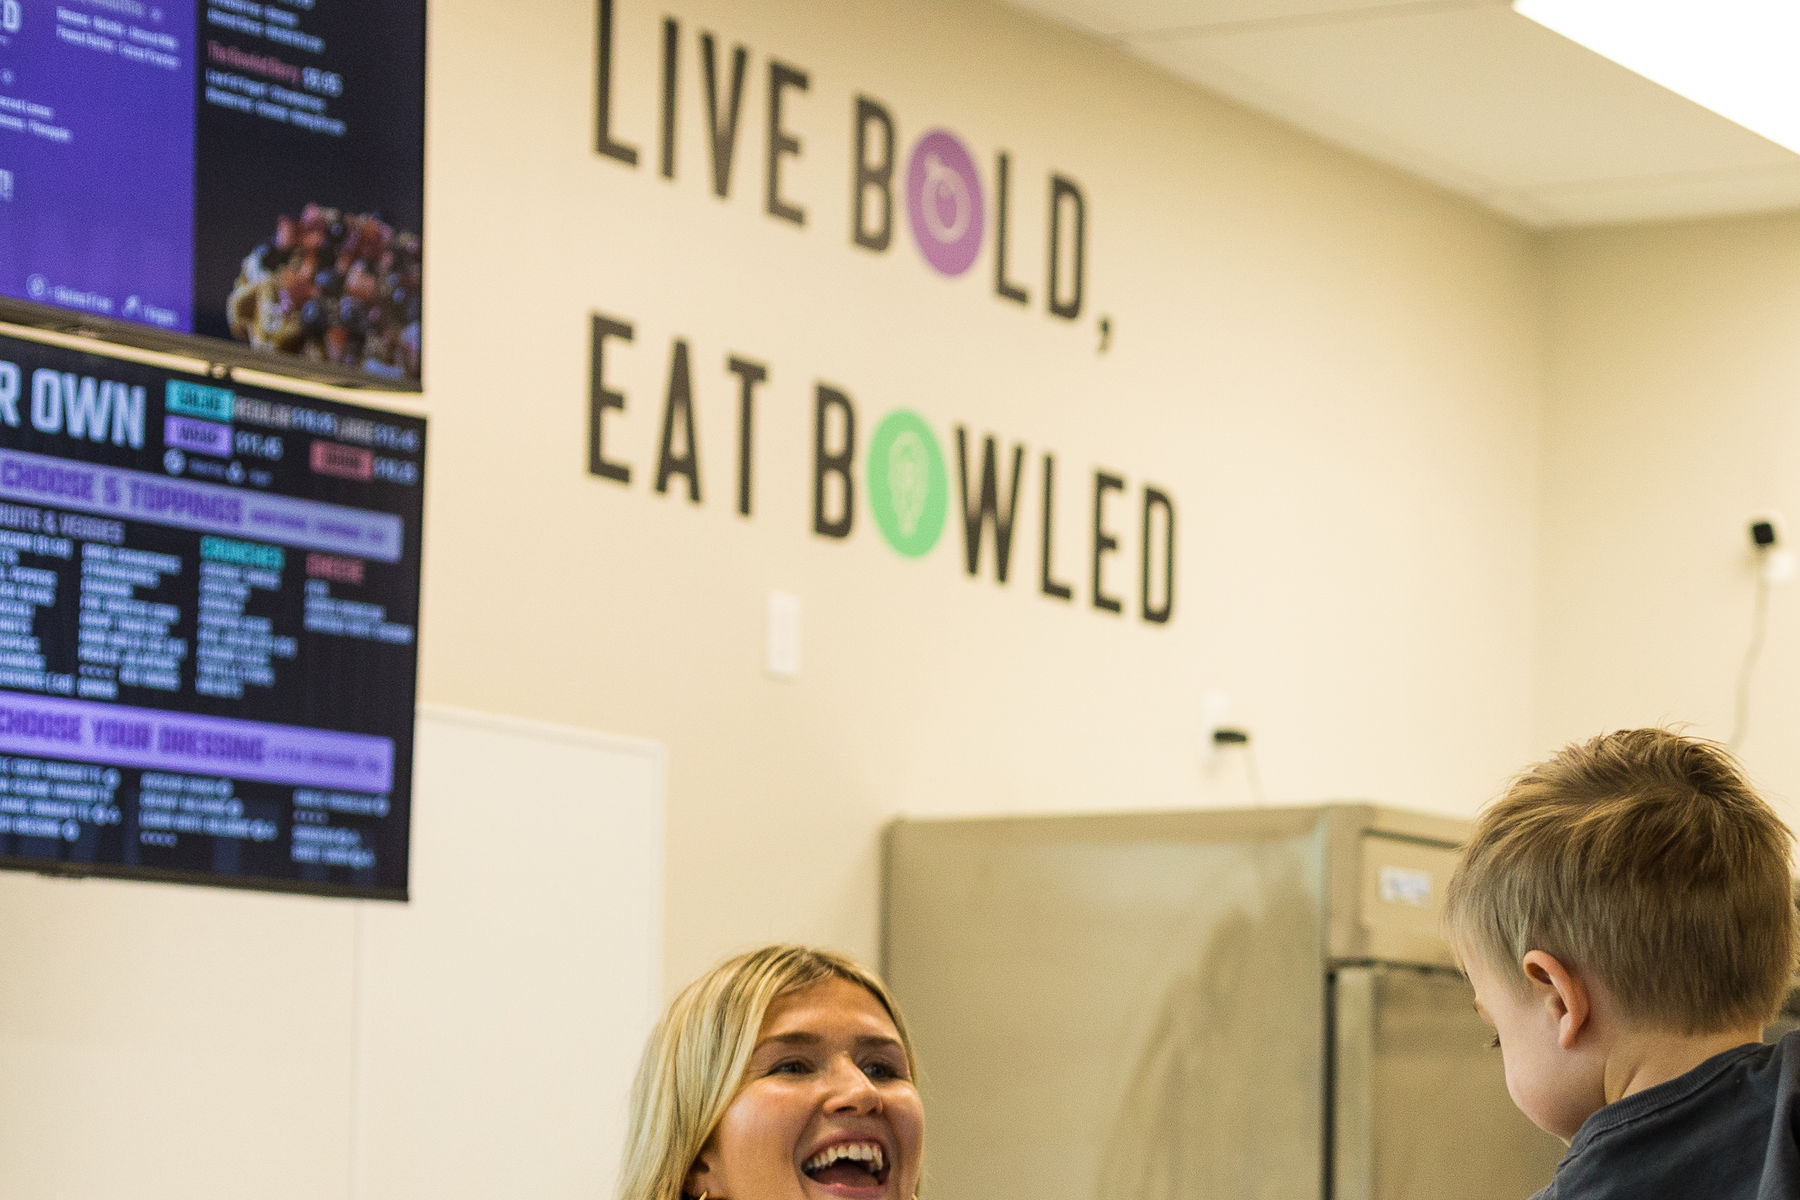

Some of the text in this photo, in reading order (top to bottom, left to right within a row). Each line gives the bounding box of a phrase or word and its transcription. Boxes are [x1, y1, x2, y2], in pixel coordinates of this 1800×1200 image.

[592, 0, 809, 227] LIVE
[31, 368, 146, 449] OWN
[586, 310, 1176, 624] EAT BOWLED
[159, 727, 264, 763] DRESSING
